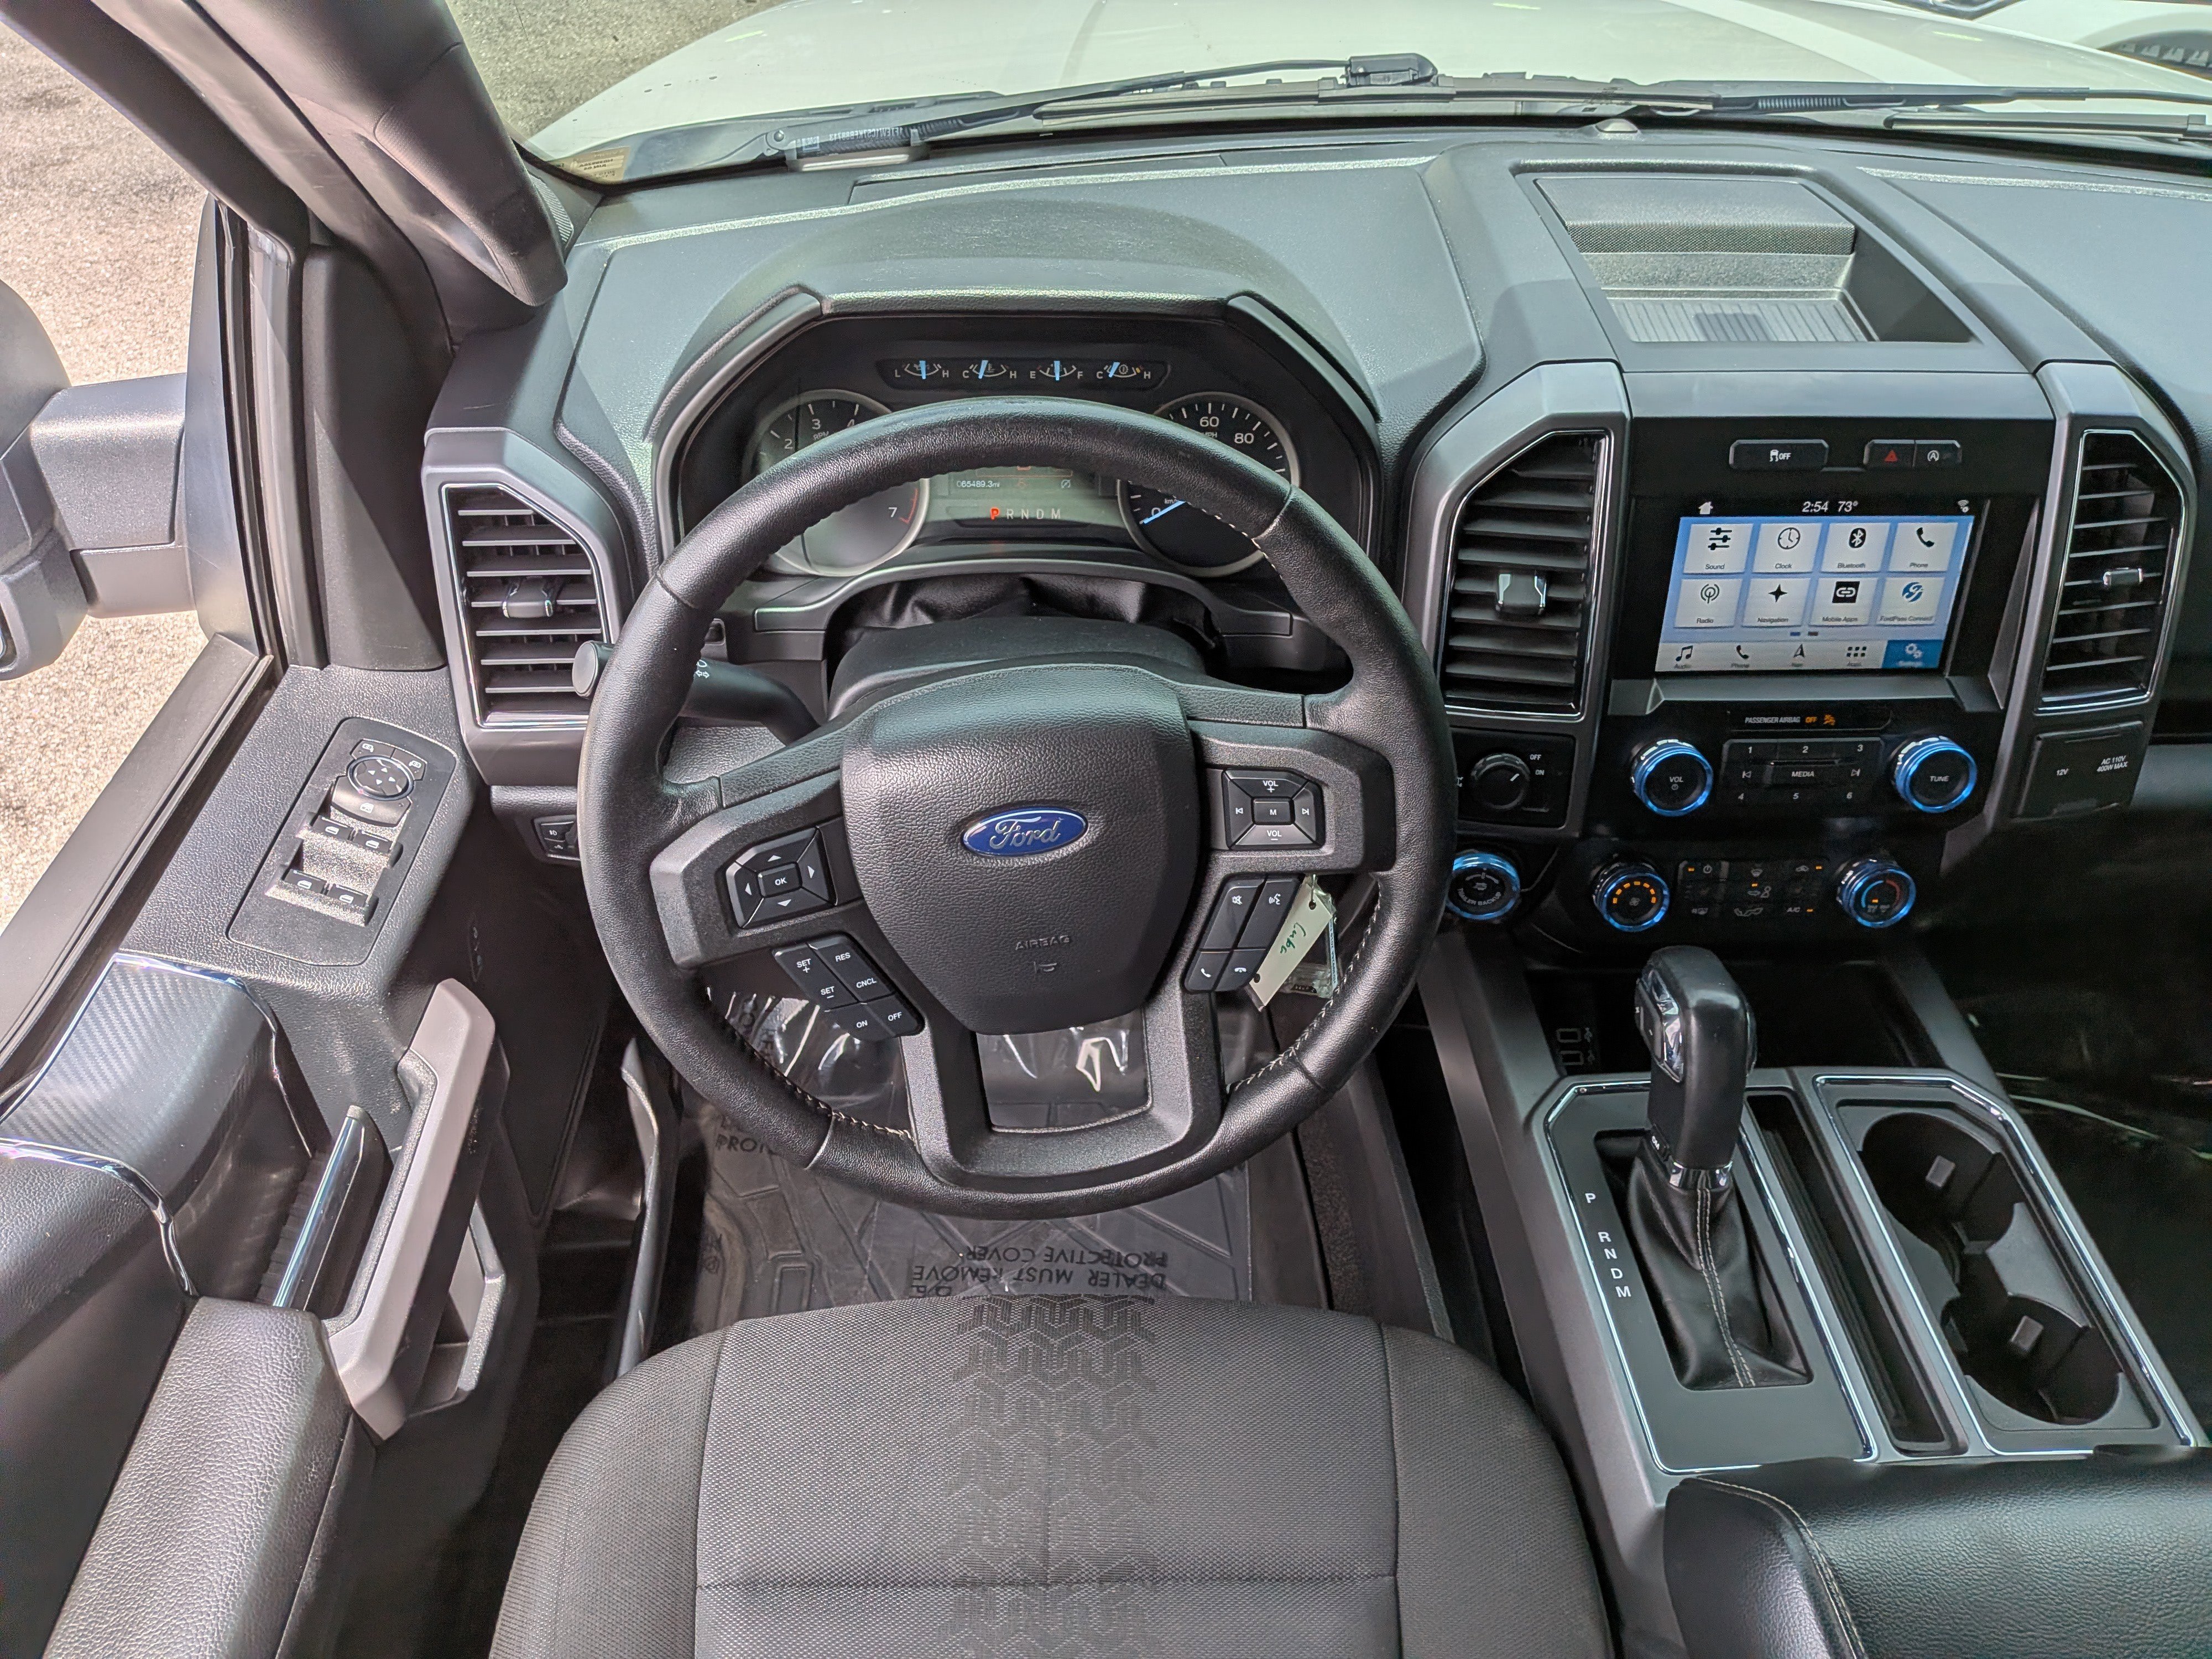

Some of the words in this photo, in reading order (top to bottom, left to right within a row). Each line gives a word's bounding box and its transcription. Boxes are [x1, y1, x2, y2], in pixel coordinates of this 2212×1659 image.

[895, 369, 901, 378] L
[812, 419, 821, 430] 3
[1199, 416, 1219, 427] 60
[784, 439, 793, 449] 2
[1234, 433, 1254, 444] 80
[888, 507, 898, 518] 7
[1802, 501, 1829, 513] 2:54
[990, 507, 999, 520] P
[1006, 509, 1014, 519] R
[1021, 509, 1029, 519] N
[1036, 509, 1044, 520] D
[1051, 508, 1061, 519] M
[989, 816, 1064, 849] Ford
[775, 877, 787, 885] OK
[835, 952, 851, 962] RES
[796, 959, 811, 968] SET
[856, 978, 877, 989] CNCL
[820, 986, 835, 996] SET
[888, 1011, 902, 1021] OFF
[856, 1020, 868, 1029] ON
[1585, 1192, 1596, 1203] P
[1598, 1232, 1611, 1243] R
[966, 1245, 1035, 1262] COVER
[1044, 1245, 1168, 1269] PROTECTIVE
[1604, 1248, 1618, 1259] N
[913, 1265, 1004, 1283] REMOVE
[1013, 1266, 1073, 1285] MUST
[1610, 1269, 1623, 1279] D
[1088, 1270, 1166, 1290] DEALER
[1616, 1286, 1631, 1297] M
